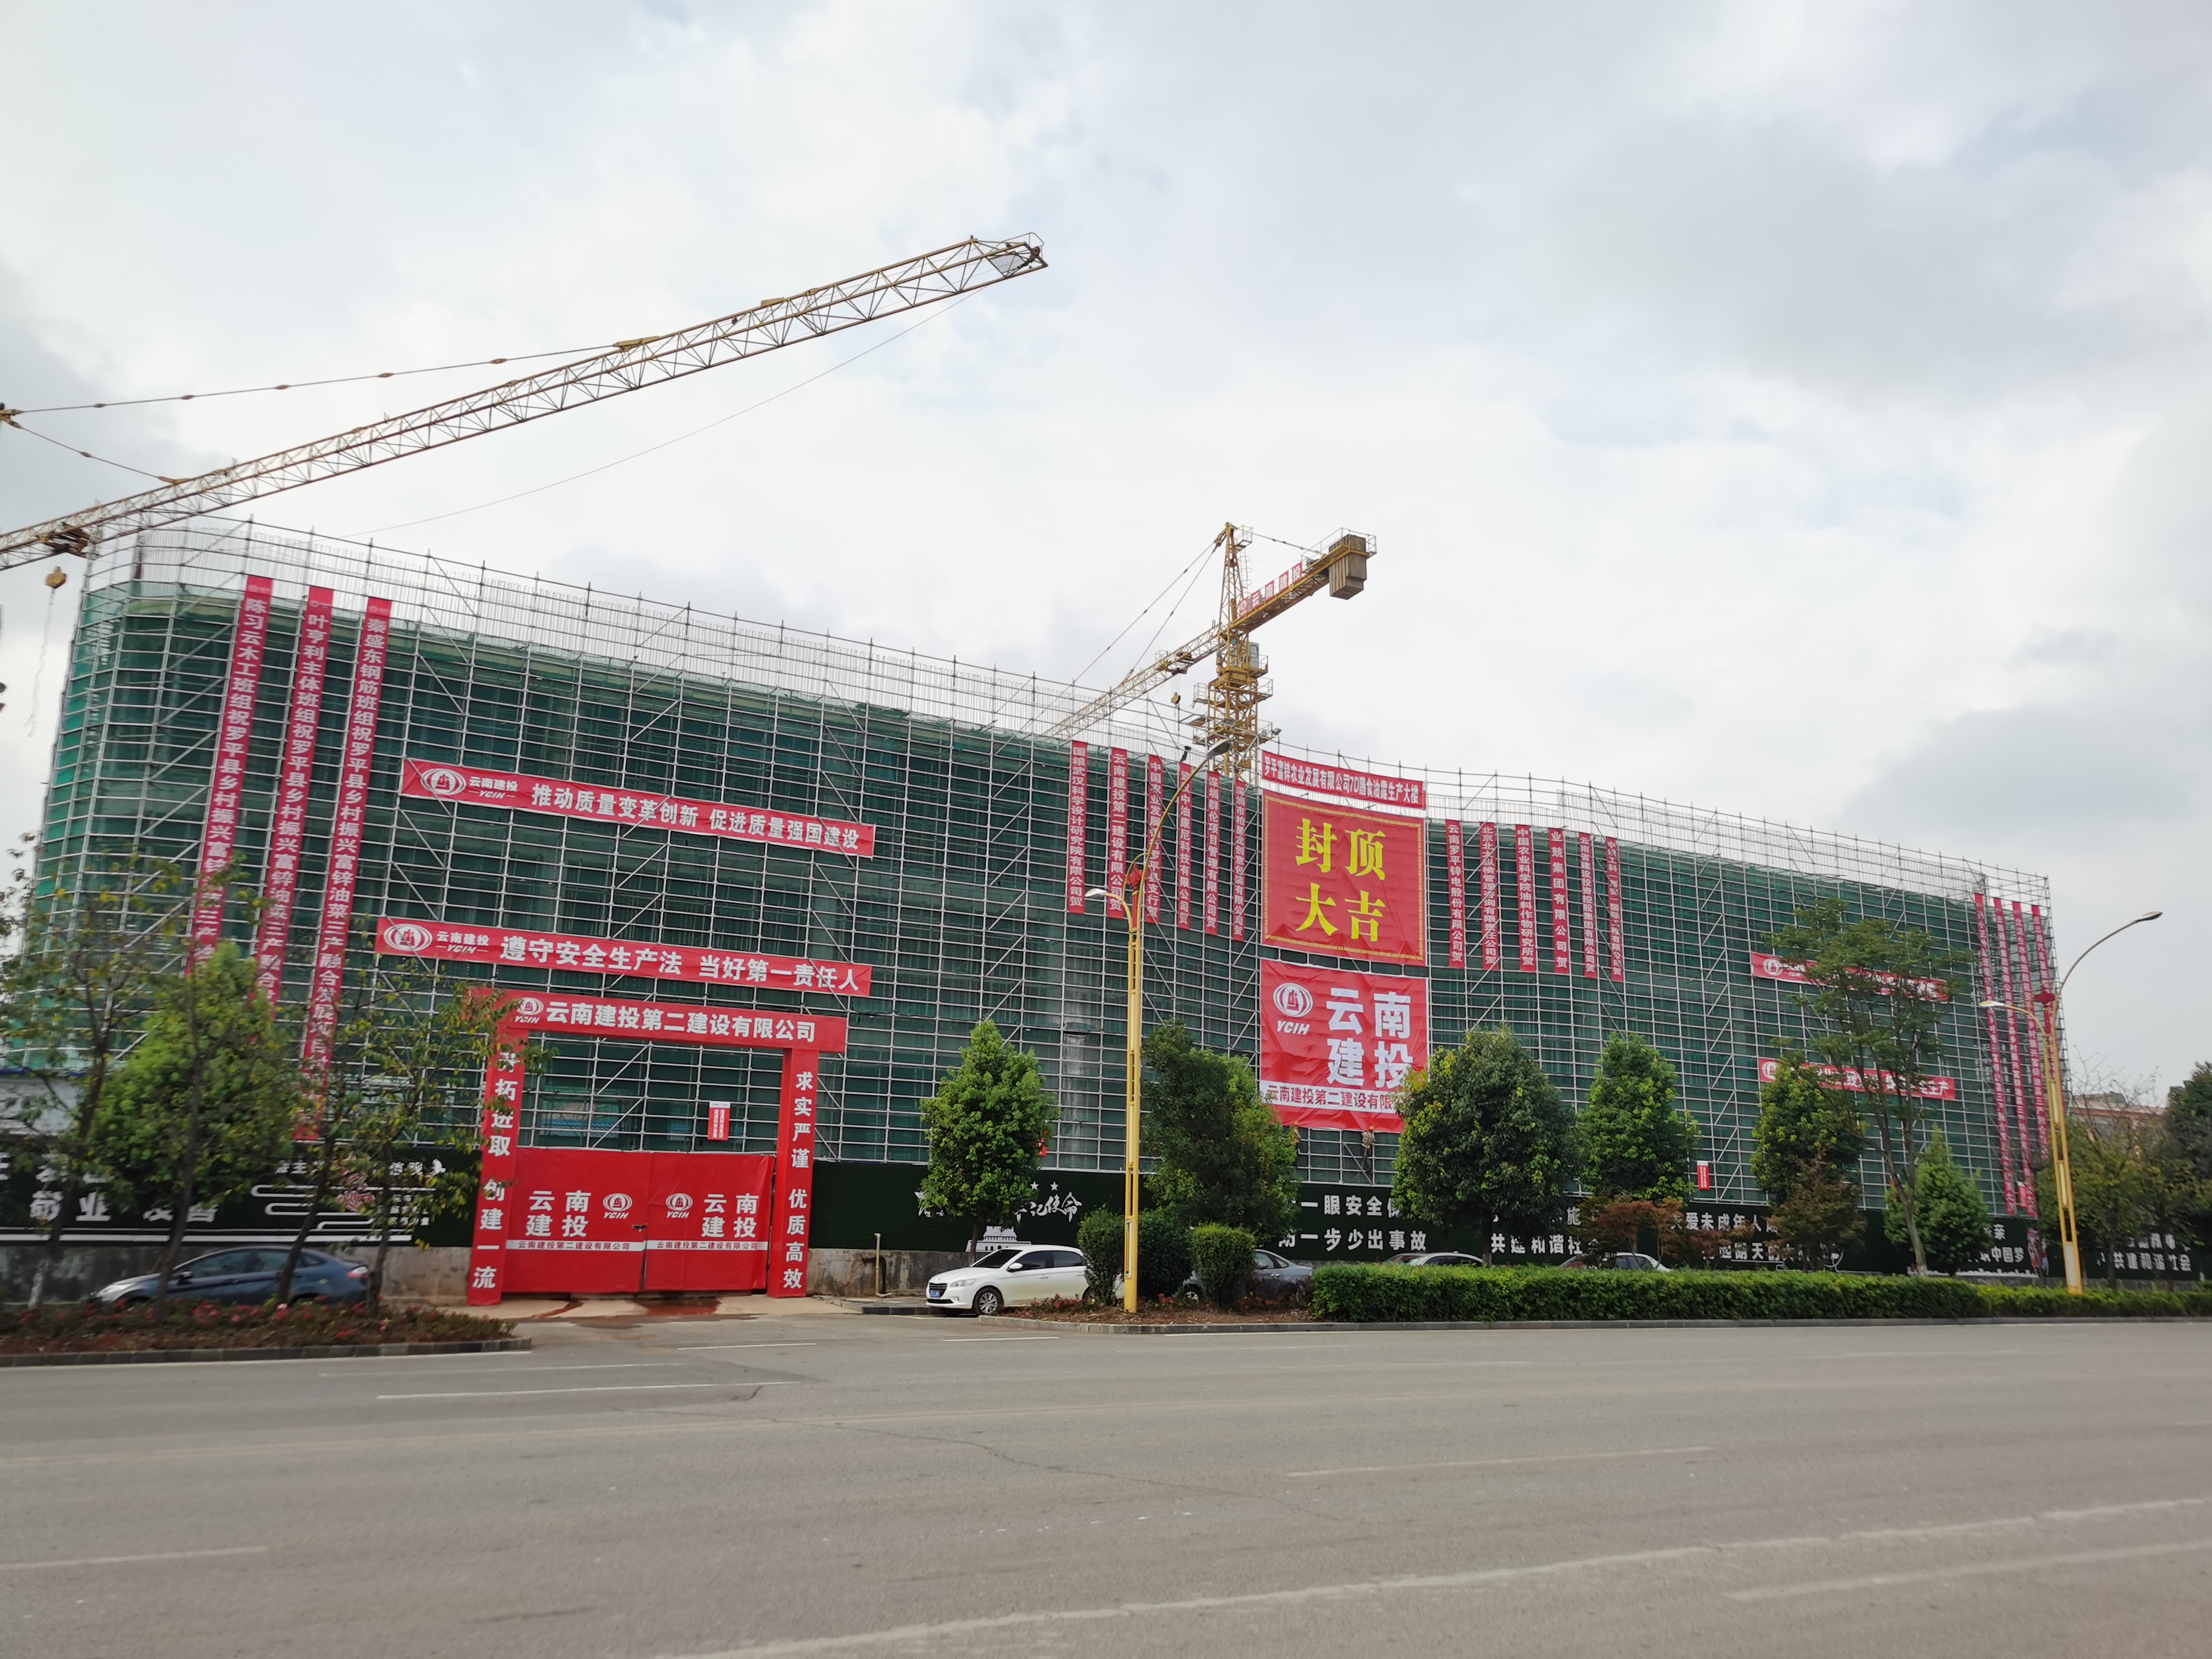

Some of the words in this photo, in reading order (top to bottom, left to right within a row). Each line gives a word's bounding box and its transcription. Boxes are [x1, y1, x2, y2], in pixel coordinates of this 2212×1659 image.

[1252, 565, 1301, 608] 云南建投
[469, 776, 518, 793] 云南建投
[479, 791, 505, 800] YCIH
[531, 782, 699, 830] 推动质量变革创新
[709, 807, 860, 851] 促进质量强国建设
[1110, 754, 1127, 911] 云南建投第二建设有限公司贺
[1295, 817, 1387, 881] 封顶
[1447, 825, 1464, 962] 云南罗平锌电股份有限公司贺
[1517, 828, 1535, 965] 中国农业科学院油料作物研究所贺
[1295, 883, 1386, 942] 大吉
[436, 931, 491, 947] 云南建投
[446, 944, 477, 954] YCIH
[500, 935, 683, 977] 遵守安全生产法
[699, 954, 860, 991] 当好第一责任人
[514, 1014, 540, 1024] YCIH
[546, 1001, 817, 1042] 云南建投第二建设有限公司
[1326, 987, 1412, 1039] 云南
[1276, 1020, 1311, 1036] YCIH
[1326, 1037, 1414, 1090] 建投
[1267, 1084, 1398, 1111] 云南建投第二建设有限
[791, 1071, 814, 1169] 求实严谨
[528, 1190, 592, 1213] 云南
[666, 1210, 691, 1219] YCIH
[703, 1193, 760, 1215] 云南
[526, 1215, 589, 1238] 建投
[603, 1211, 629, 1220] YCIH
[702, 1216, 757, 1239] 建投
[472, 1178, 506, 1290] 创建一流
[518, 1241, 631, 1252] 云南建投第二建设有限公司
[656, 1241, 760, 1252] 云南建投第二建设有限公司
[783, 1188, 808, 1289] 优质高效
